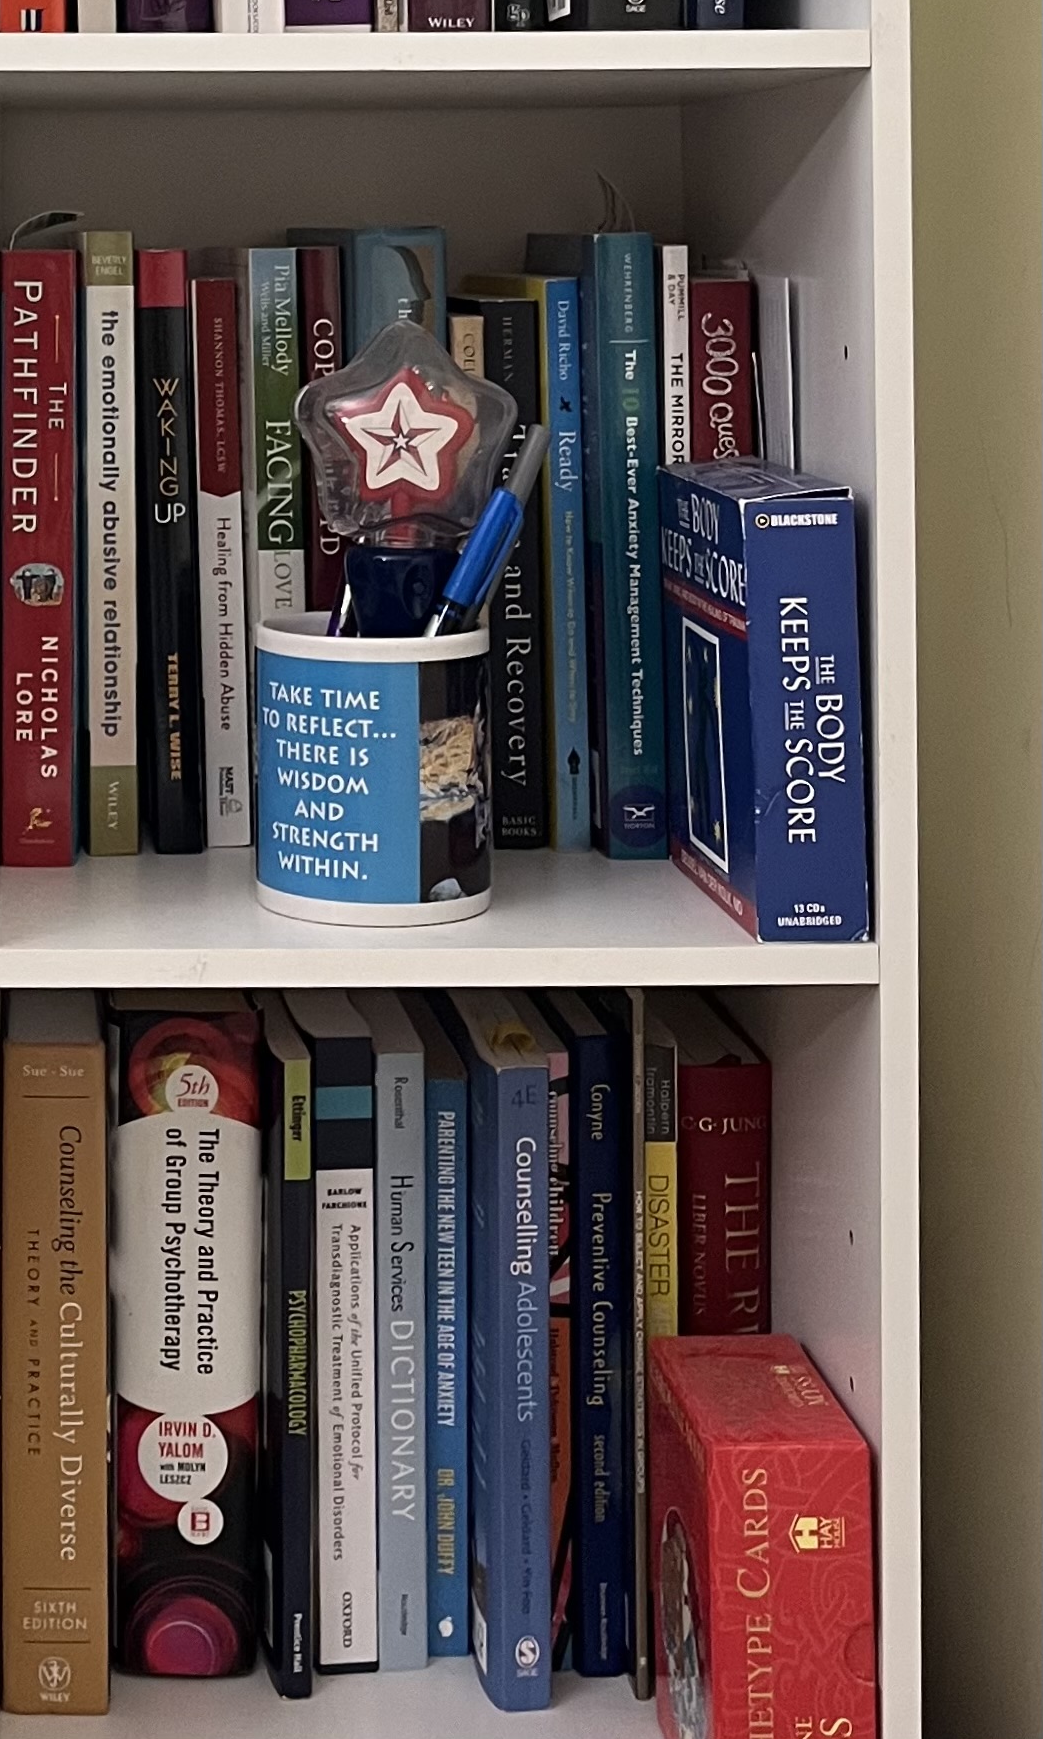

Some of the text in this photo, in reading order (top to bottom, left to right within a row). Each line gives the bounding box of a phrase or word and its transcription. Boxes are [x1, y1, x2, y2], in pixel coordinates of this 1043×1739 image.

[12, 281, 42, 533] PATHFINDER
[49, 383, 67, 430] THE
[670, 353, 685, 464] THE MIRROR
[98, 311, 121, 737] the emotionally abusive relationship
[155, 502, 186, 524] UP
[623, 350, 644, 755] The 10 Best-Ever Anxiety Management Techniques
[770, 513, 838, 526] BLACKSTONE
[213, 518, 233, 730] Healing from Hidden Abuse
[16, 673, 32, 742] LORE
[41, 636, 58, 779] NICHOLAS
[263, 707, 279, 729] TO
[269, 682, 380, 711] TAKE TIME
[276, 739, 369, 765] THERE IS
[779, 597, 816, 844] KEEPS THE SCORE
[816, 655, 845, 783] THE BODY
[278, 767, 369, 795] WISDOM
[294, 802, 344, 821] AND
[273, 822, 378, 852] STRENGTH
[278, 852, 368, 881] WITHIN.
[777, 916, 841, 926] UNABRIDGED
[161, 1129, 186, 1371] of Group Psychotherapy
[195, 1129, 219, 1374] The Theory and Practice
[648, 1175, 669, 1297] DISASTER
[52, 1125, 83, 1560] Counseling the Culturally Diverse
[586, 1193, 613, 1406] Preventive Counseling
[738, 1468, 771, 1599] CARDS
[342, 1592, 353, 1648] OXFORD
